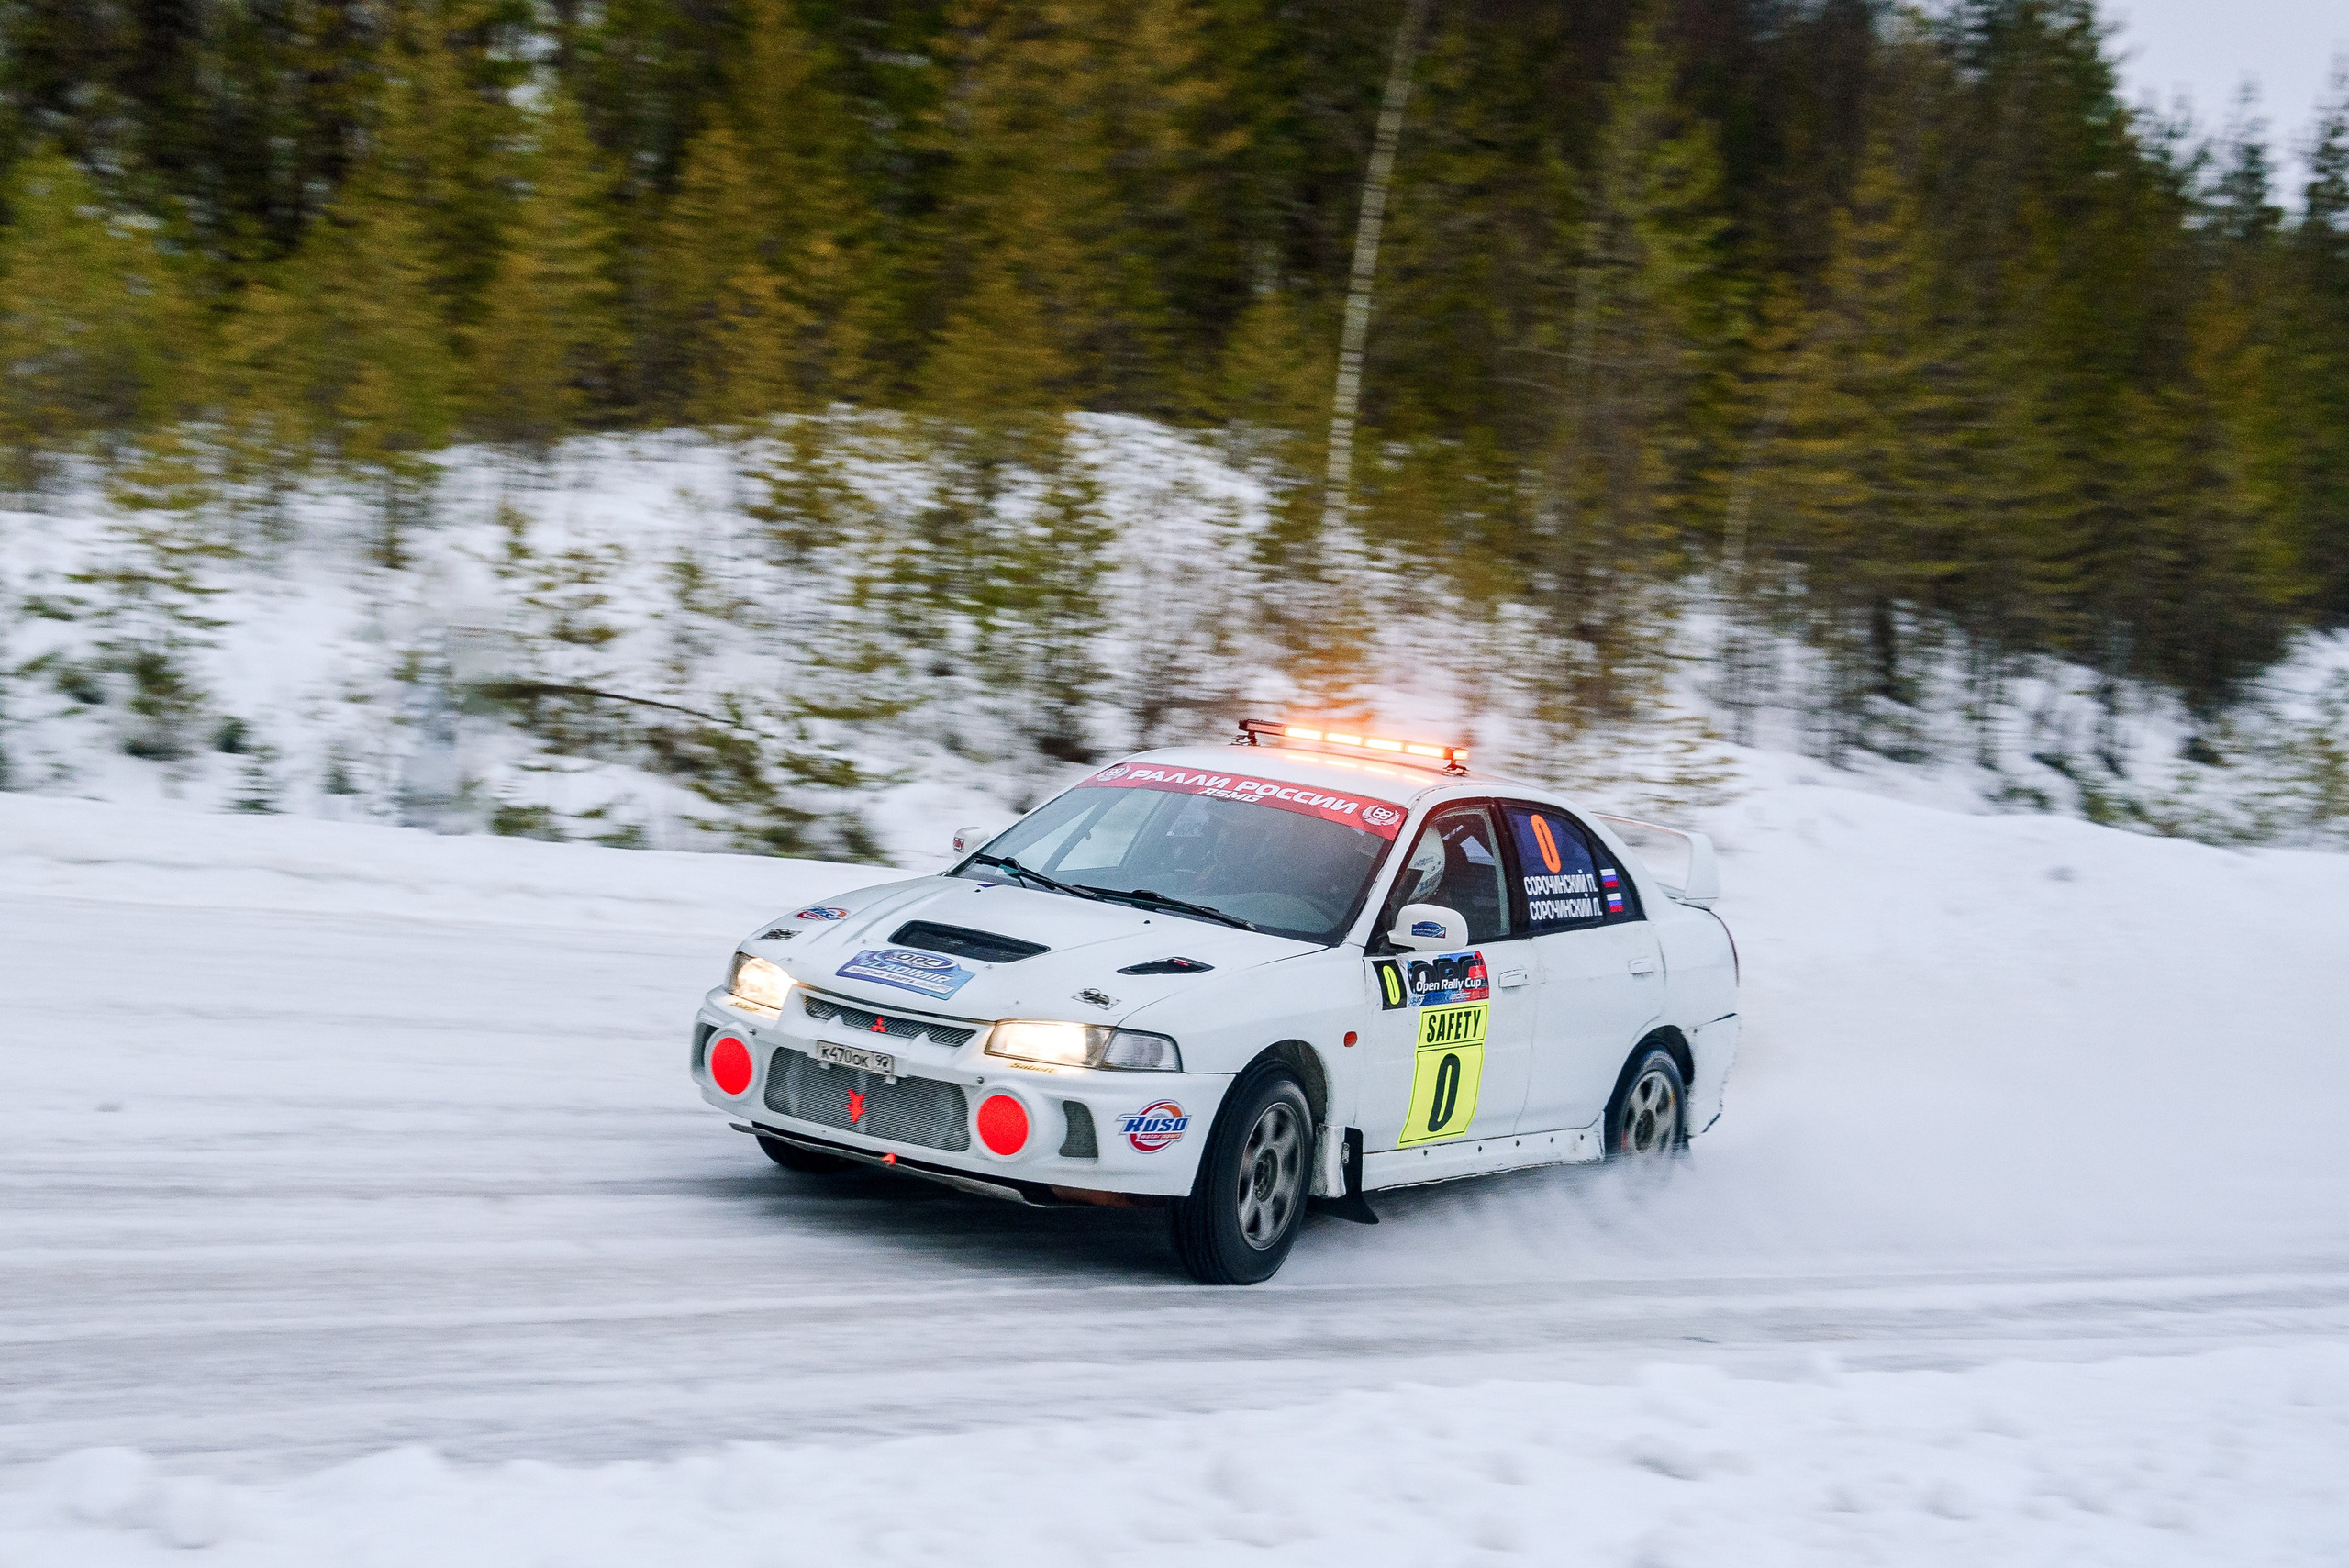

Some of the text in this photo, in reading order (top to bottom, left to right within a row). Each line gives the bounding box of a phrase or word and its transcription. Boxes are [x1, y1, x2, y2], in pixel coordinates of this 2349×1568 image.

[1127, 769, 1359, 815] РАЛЛИ РОССИИ
[1523, 869, 1588, 895] СОРОЧИНСКИЙ
[1529, 893, 1593, 920] СОРОЧИНСКИЙ
[859, 960, 953, 983] VLADIMIR
[897, 953, 941, 967] ORC
[1416, 977, 1482, 994] Open Rally Cup
[1426, 1009, 1481, 1043] SAFETY
[1427, 1053, 1461, 1132] 0
